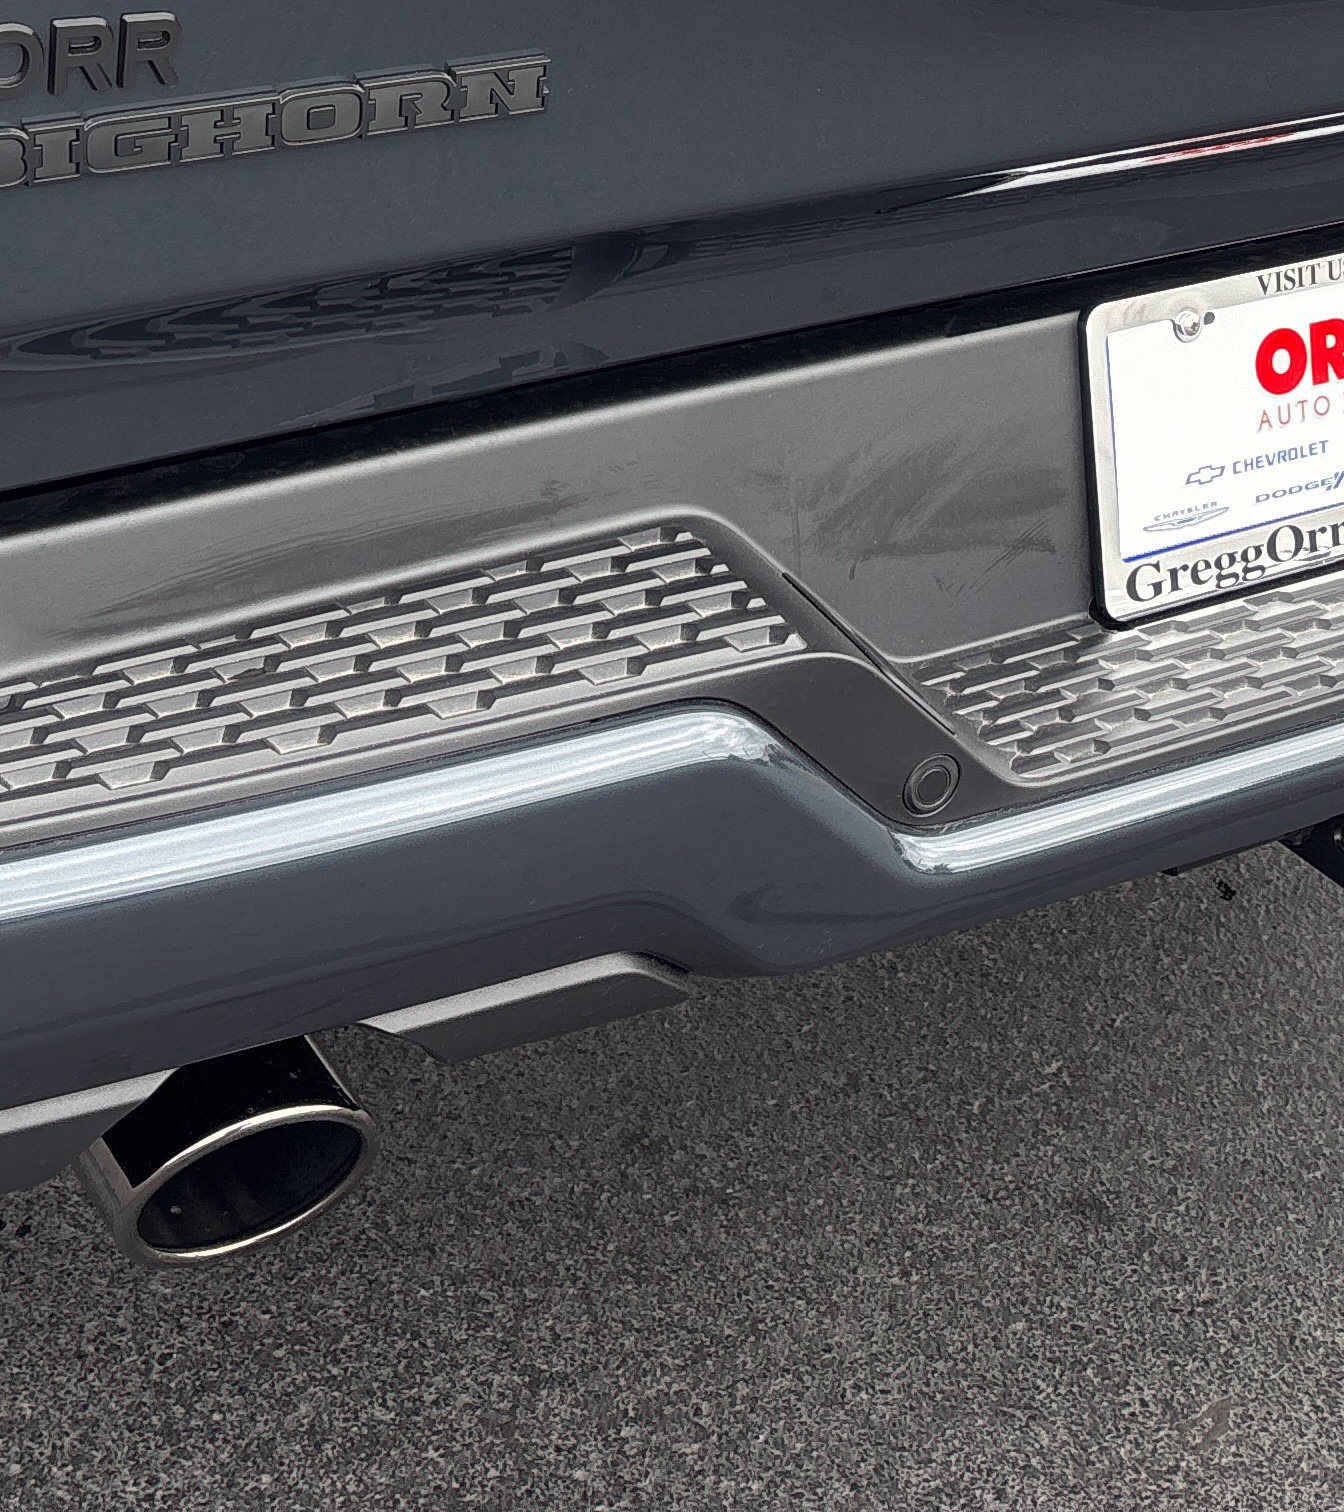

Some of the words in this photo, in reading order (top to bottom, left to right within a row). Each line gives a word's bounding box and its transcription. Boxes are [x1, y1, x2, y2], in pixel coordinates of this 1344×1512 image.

[1257, 263, 1323, 296] VISIT
[1258, 395, 1331, 433] AUTO
[1232, 440, 1330, 475] CHEVROLET
[1154, 501, 1218, 522] CHRYSLER
[1255, 476, 1335, 503] DODGE
